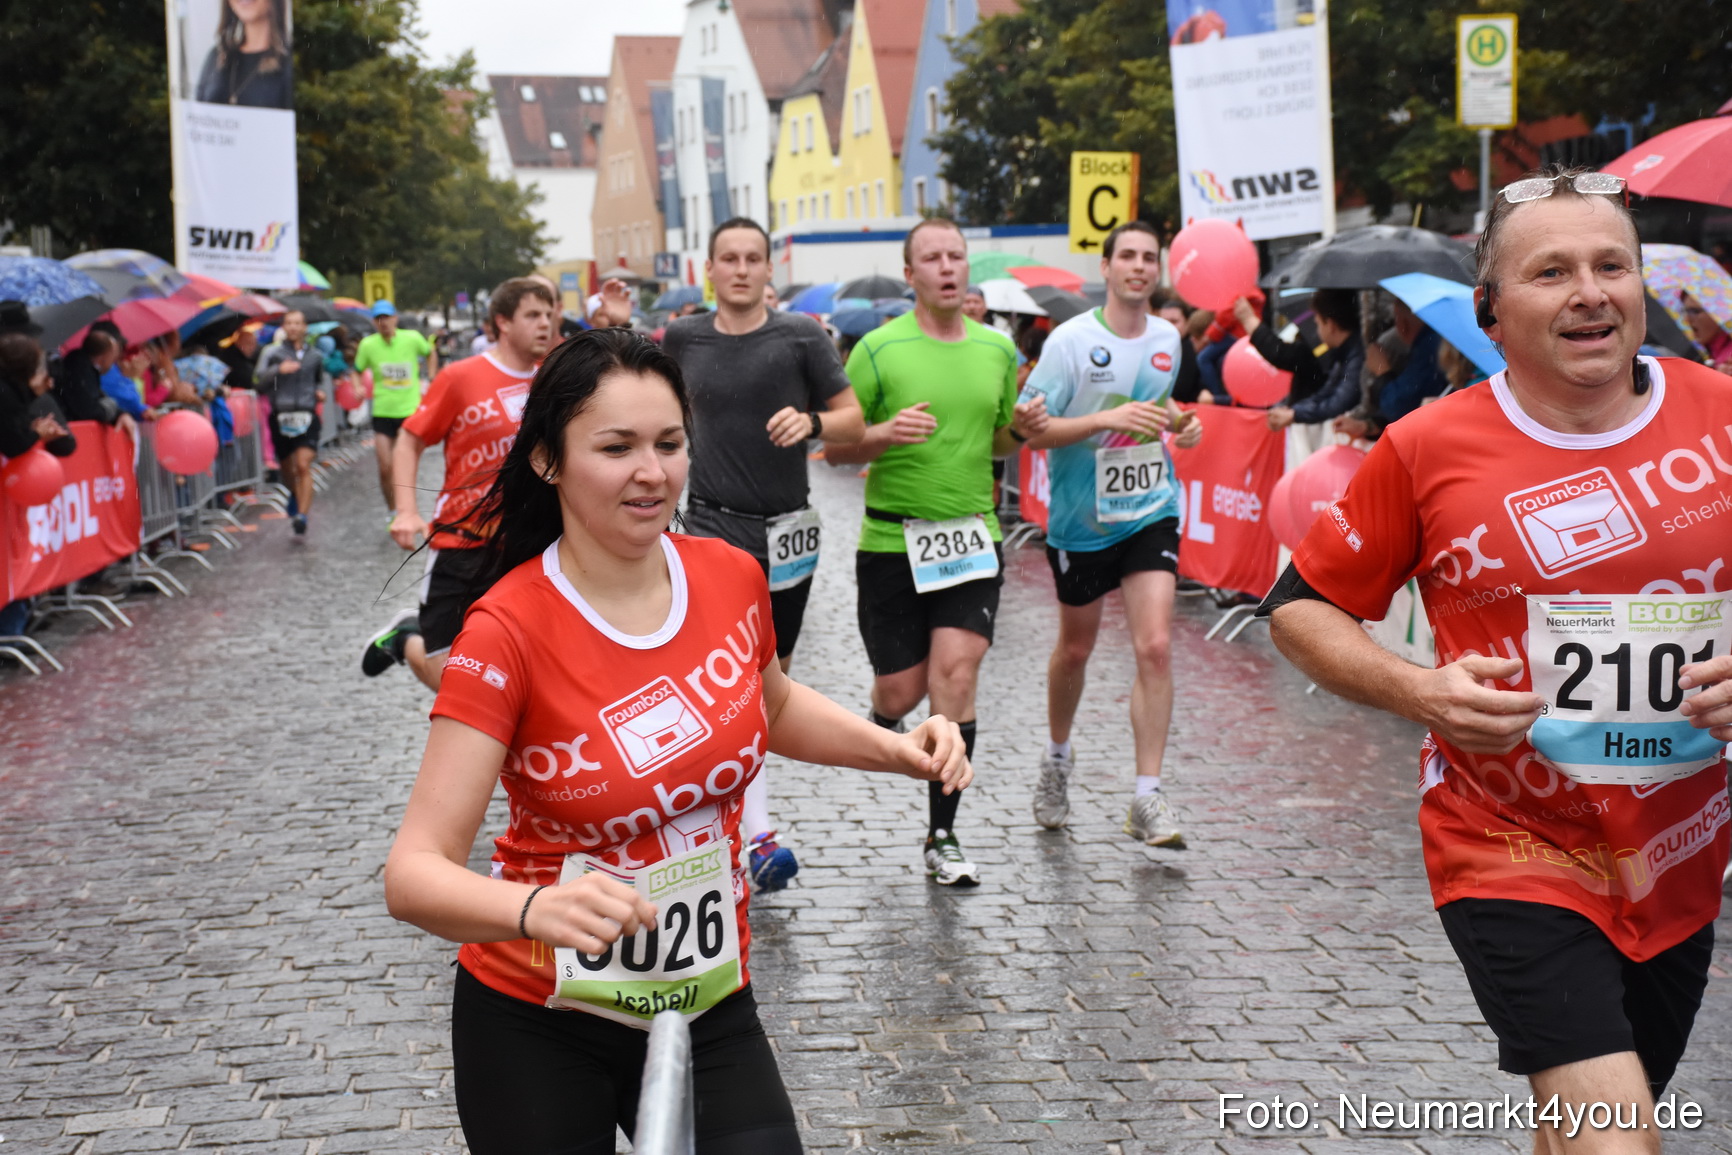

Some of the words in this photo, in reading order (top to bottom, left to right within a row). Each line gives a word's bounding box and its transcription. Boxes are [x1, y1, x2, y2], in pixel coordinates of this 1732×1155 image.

[1477, 35, 1497, 56] H
[1080, 158, 1130, 176] Block
[1088, 184, 1119, 231] C
[189, 226, 255, 251] swn
[1105, 461, 1163, 493] 2607
[1212, 484, 1263, 523] energie
[1514, 476, 1608, 515] raumbox
[777, 526, 820, 560] 308
[917, 530, 984, 562] 2384
[938, 561, 974, 577] Martin
[1546, 617, 1616, 627] NeuerMarkt
[1628, 600, 1722, 624] BOCK
[1628, 625, 1661, 633] inspired
[1662, 625, 1673, 633] by
[607, 684, 673, 727] raumbox
[1604, 731, 1673, 759] Hans
[534, 780, 609, 802] outdoor
[649, 849, 722, 894] BOCK
[565, 966, 573, 977] S
[613, 984, 699, 1015] Isabell
